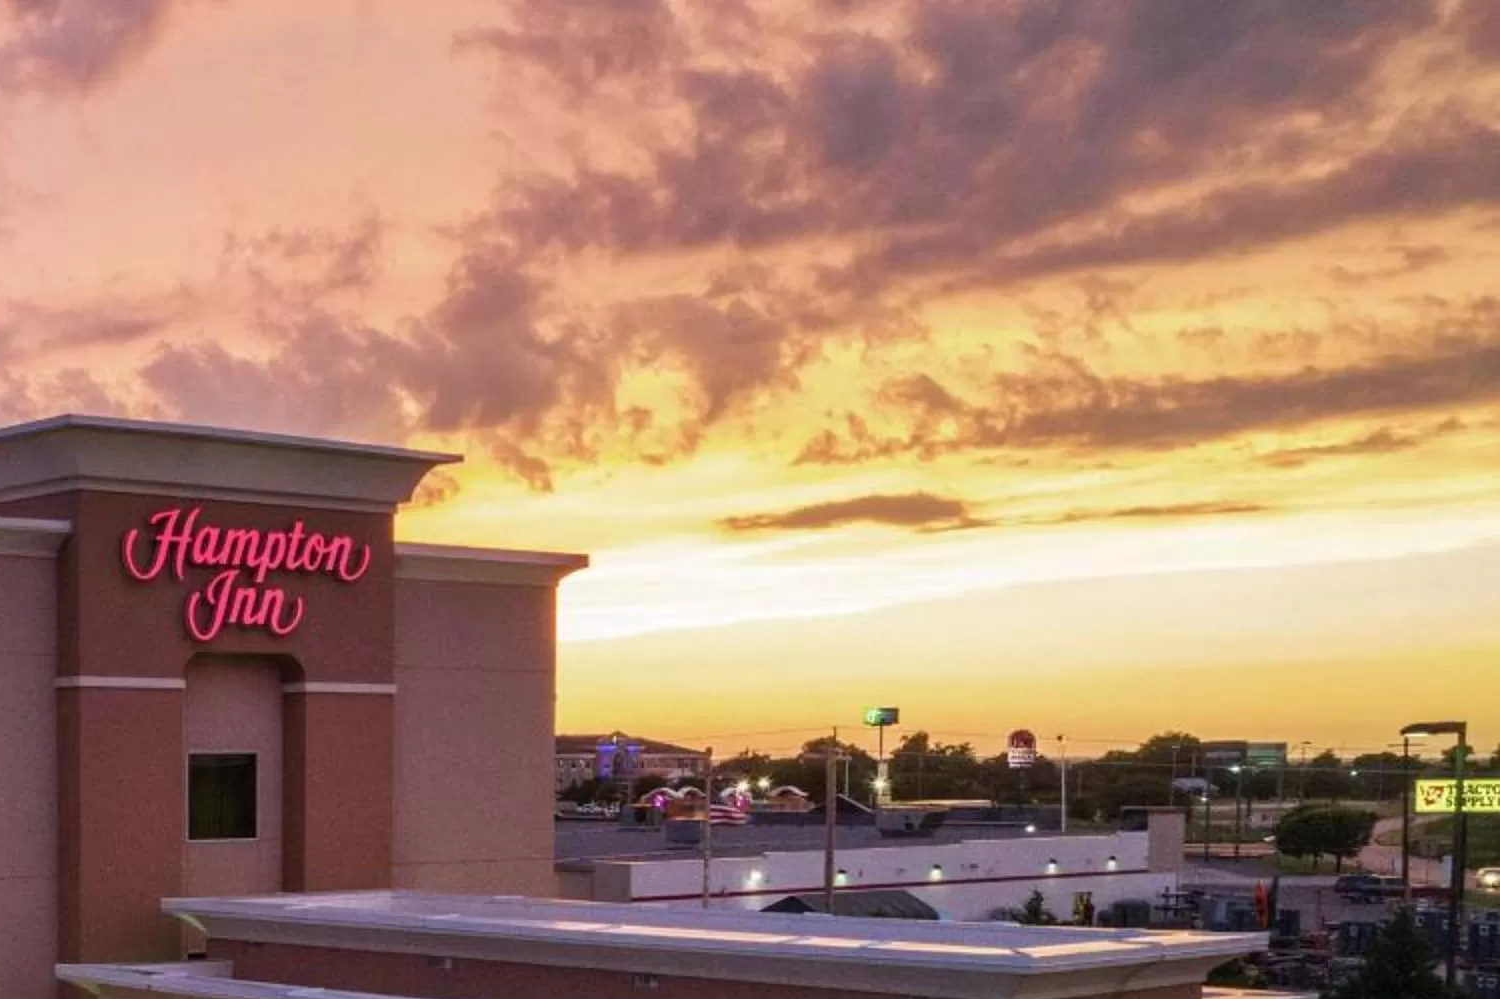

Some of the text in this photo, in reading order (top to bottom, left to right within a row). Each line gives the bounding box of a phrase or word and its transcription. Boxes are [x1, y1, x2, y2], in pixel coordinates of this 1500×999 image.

[125, 507, 370, 582] Hampton
[188, 569, 304, 640] Inn
[1446, 784, 1500, 795] TACTO
